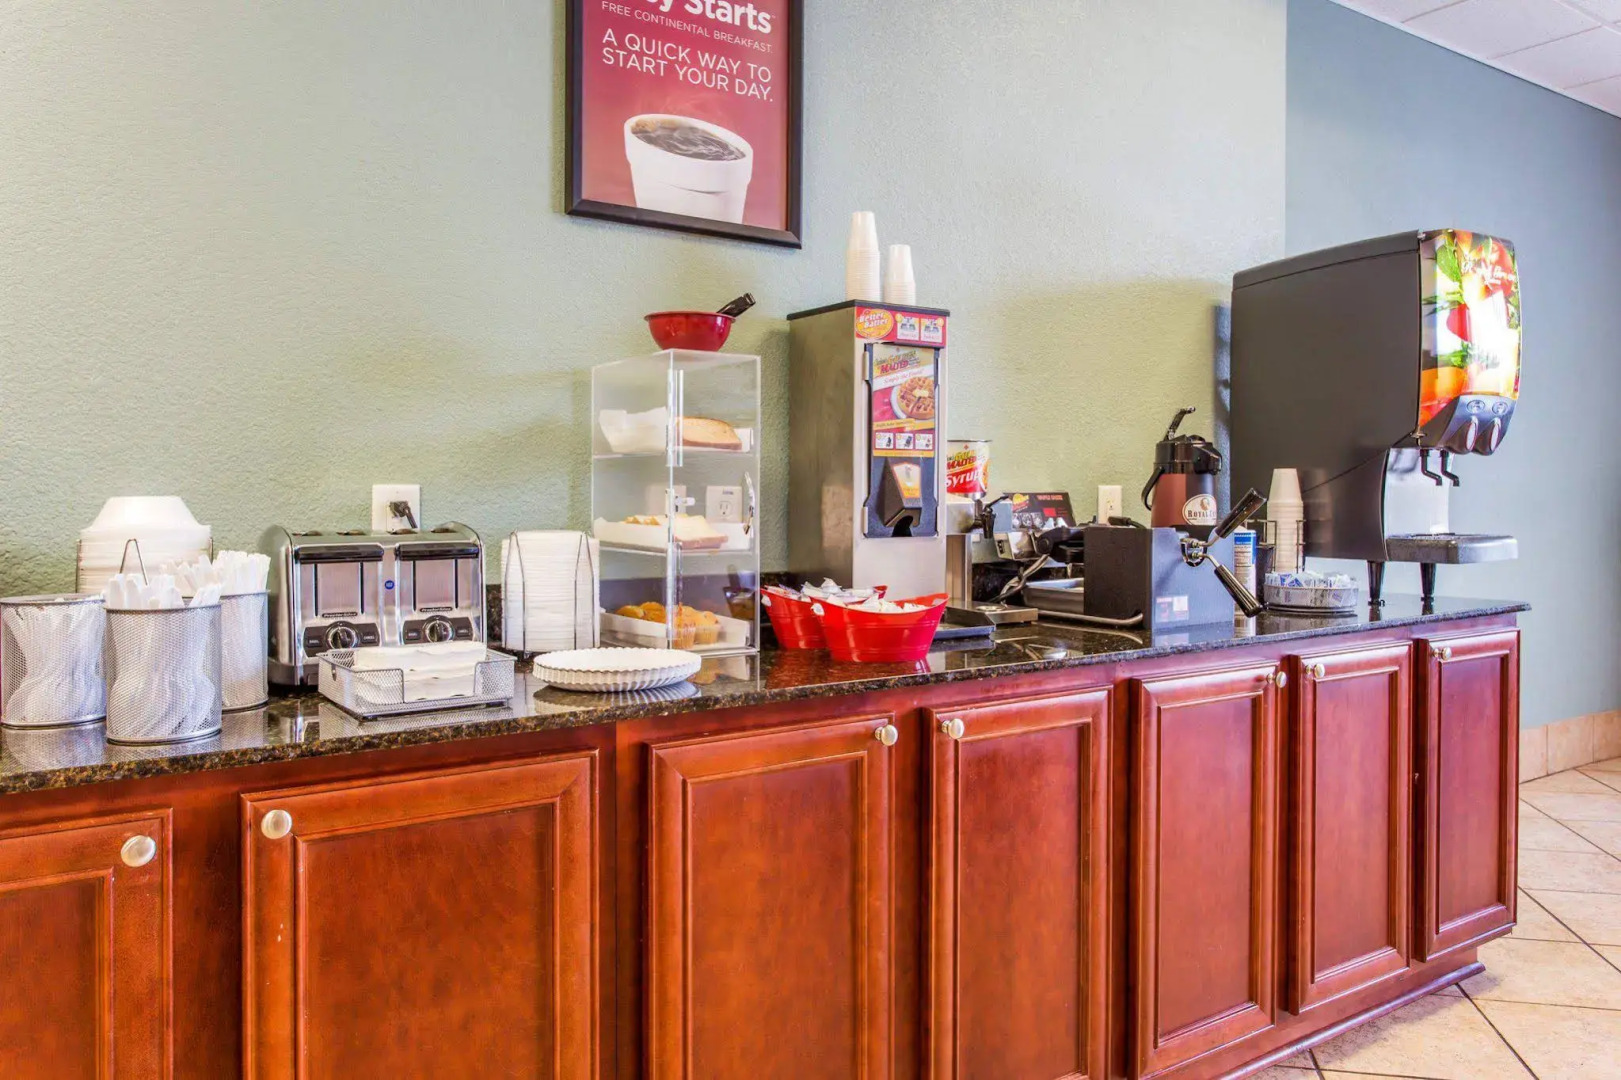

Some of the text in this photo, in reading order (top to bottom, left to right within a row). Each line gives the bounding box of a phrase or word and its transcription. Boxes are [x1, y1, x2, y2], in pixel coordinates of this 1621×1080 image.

[601, 1, 631, 17] FREE
[634, 9, 710, 38] CONTINENTAL
[684, 0, 772, 34] Starts
[602, 28, 772, 83] A QUICK WAY TO
[602, 47, 773, 102] START YOUR DAY.
[1187, 509, 1209, 518] ROYAL
